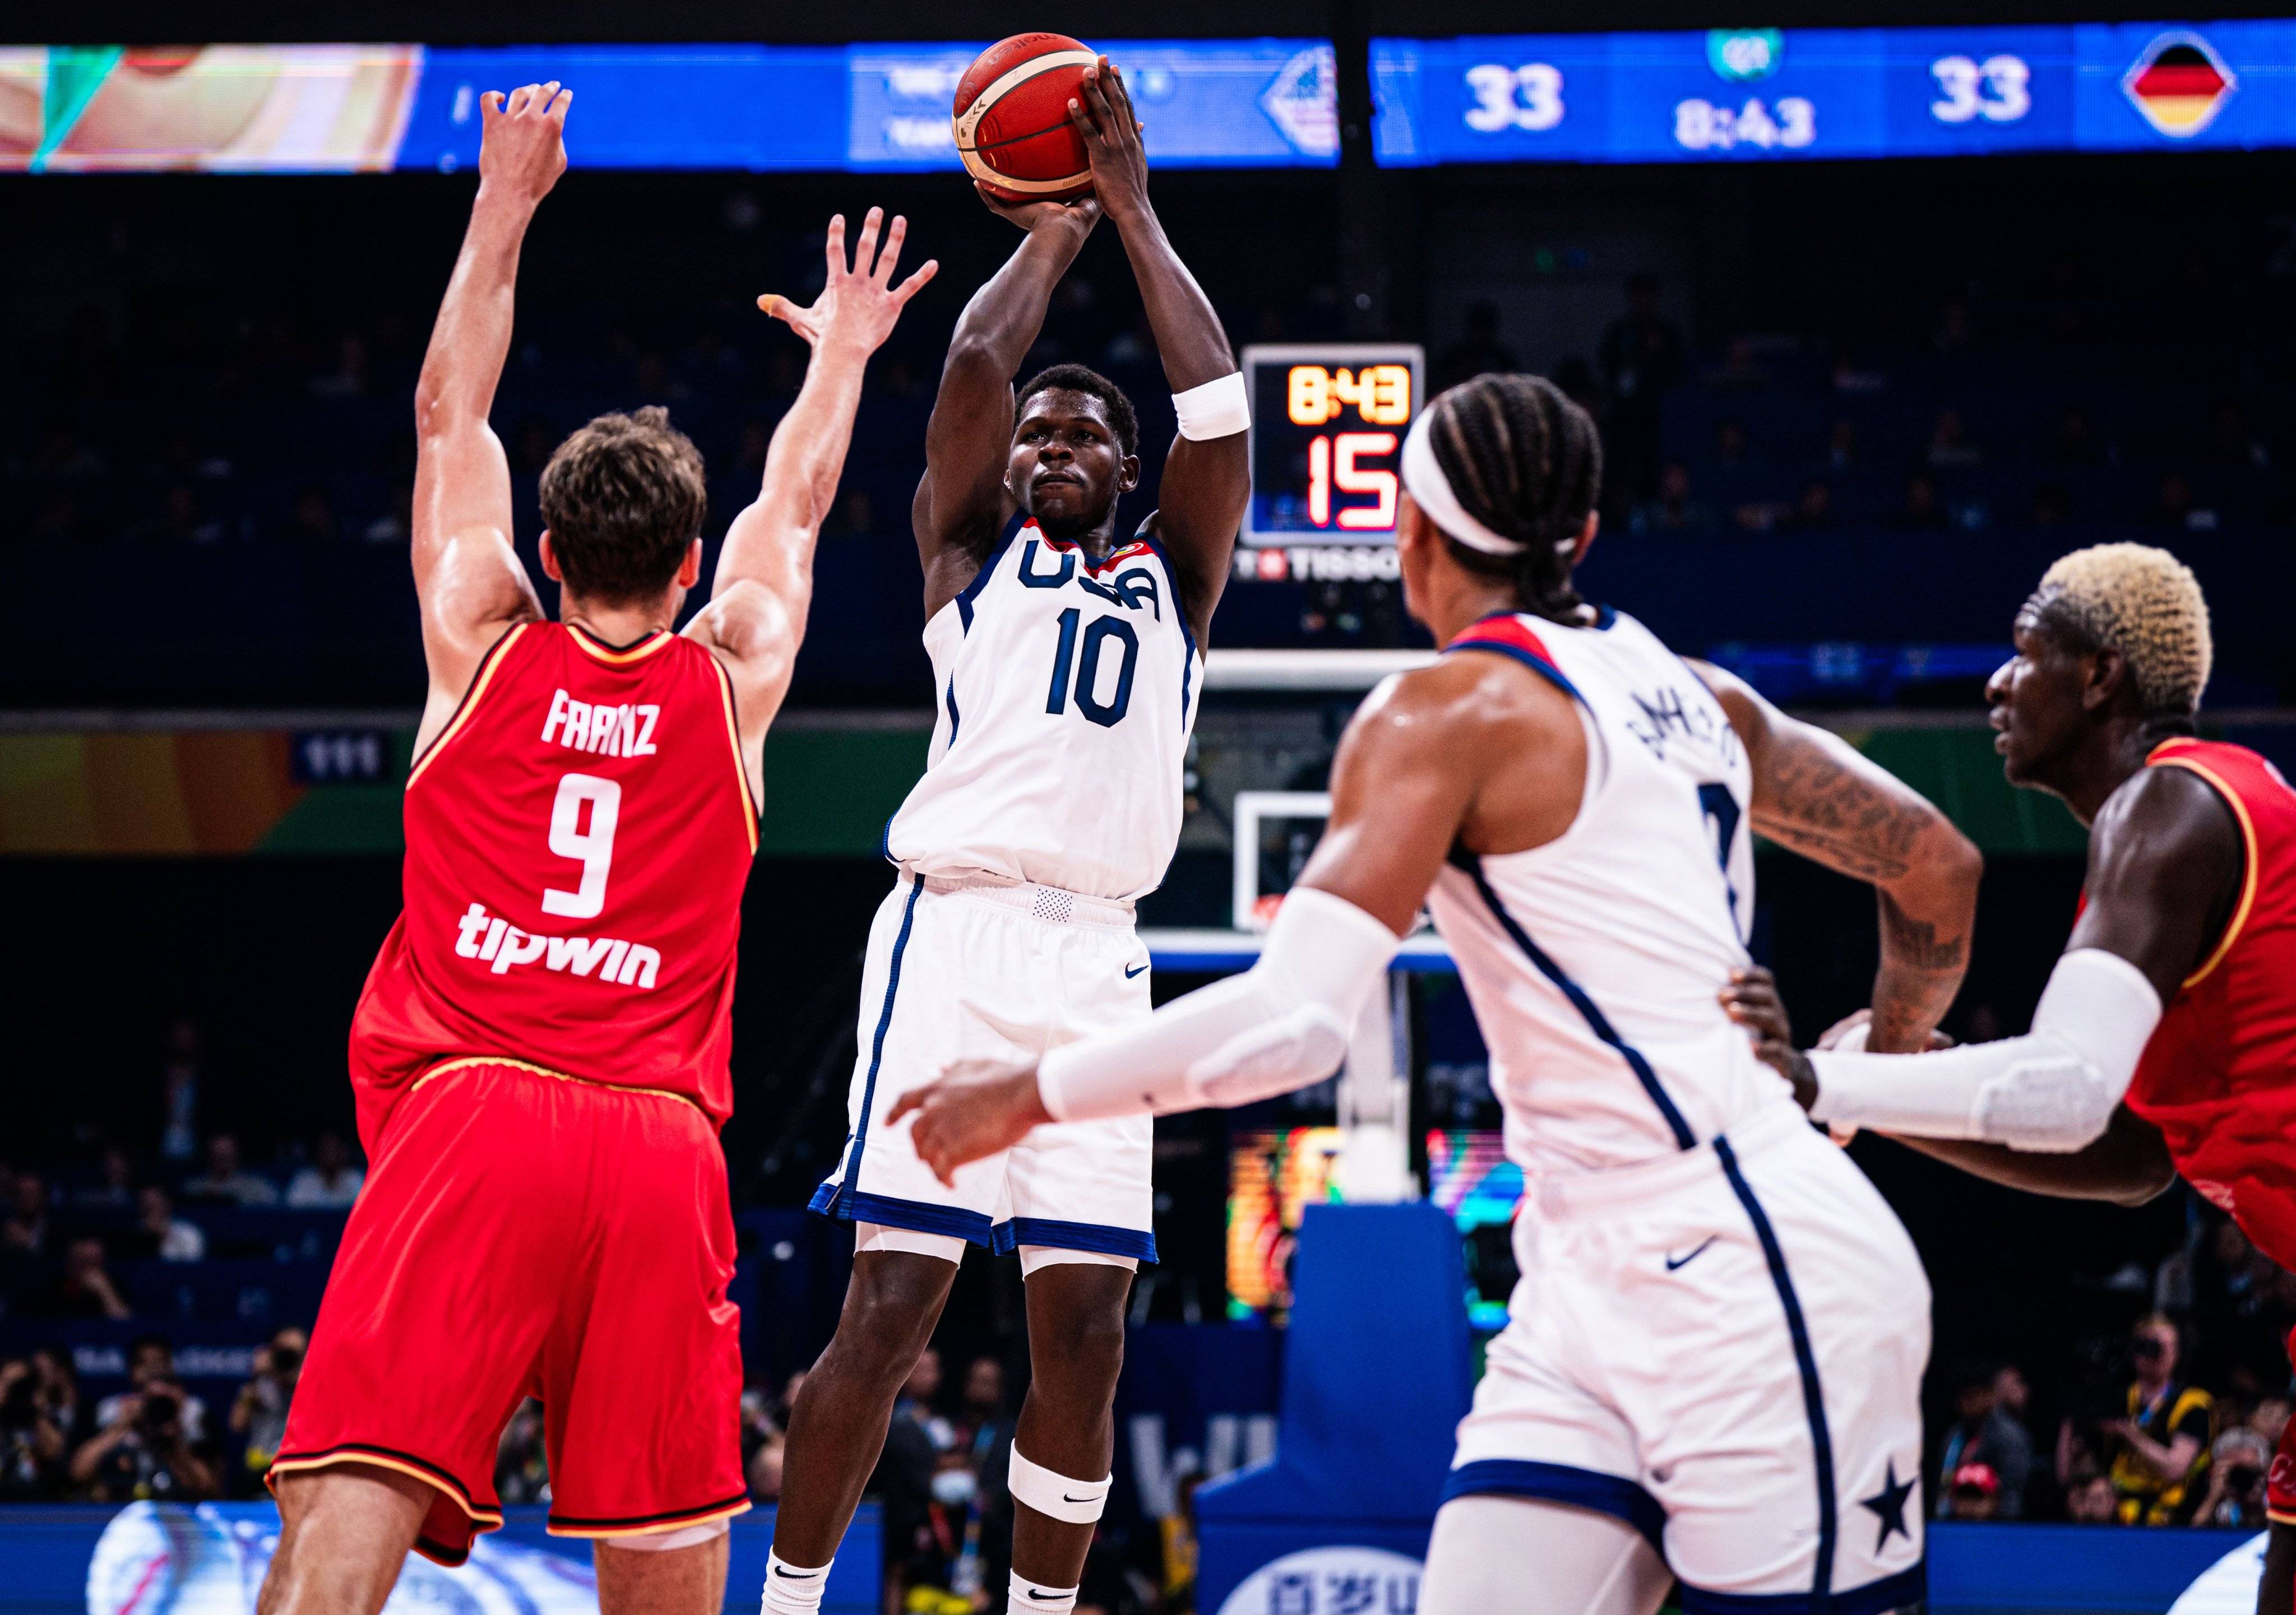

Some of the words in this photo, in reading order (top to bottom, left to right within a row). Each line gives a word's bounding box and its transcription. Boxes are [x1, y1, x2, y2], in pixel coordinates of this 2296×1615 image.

[1464, 63, 1564, 131] 33
[1931, 54, 2030, 123] 33
[1674, 98, 1817, 150] 8:43
[1289, 365, 1411, 426] 8:43
[1308, 433, 1399, 532] 15
[1290, 547, 1401, 583] TISSO
[1045, 607, 1140, 728] 10
[540, 688, 661, 758] FRANZ
[541, 773, 622, 919] 9
[454, 902, 661, 989] tipwin
